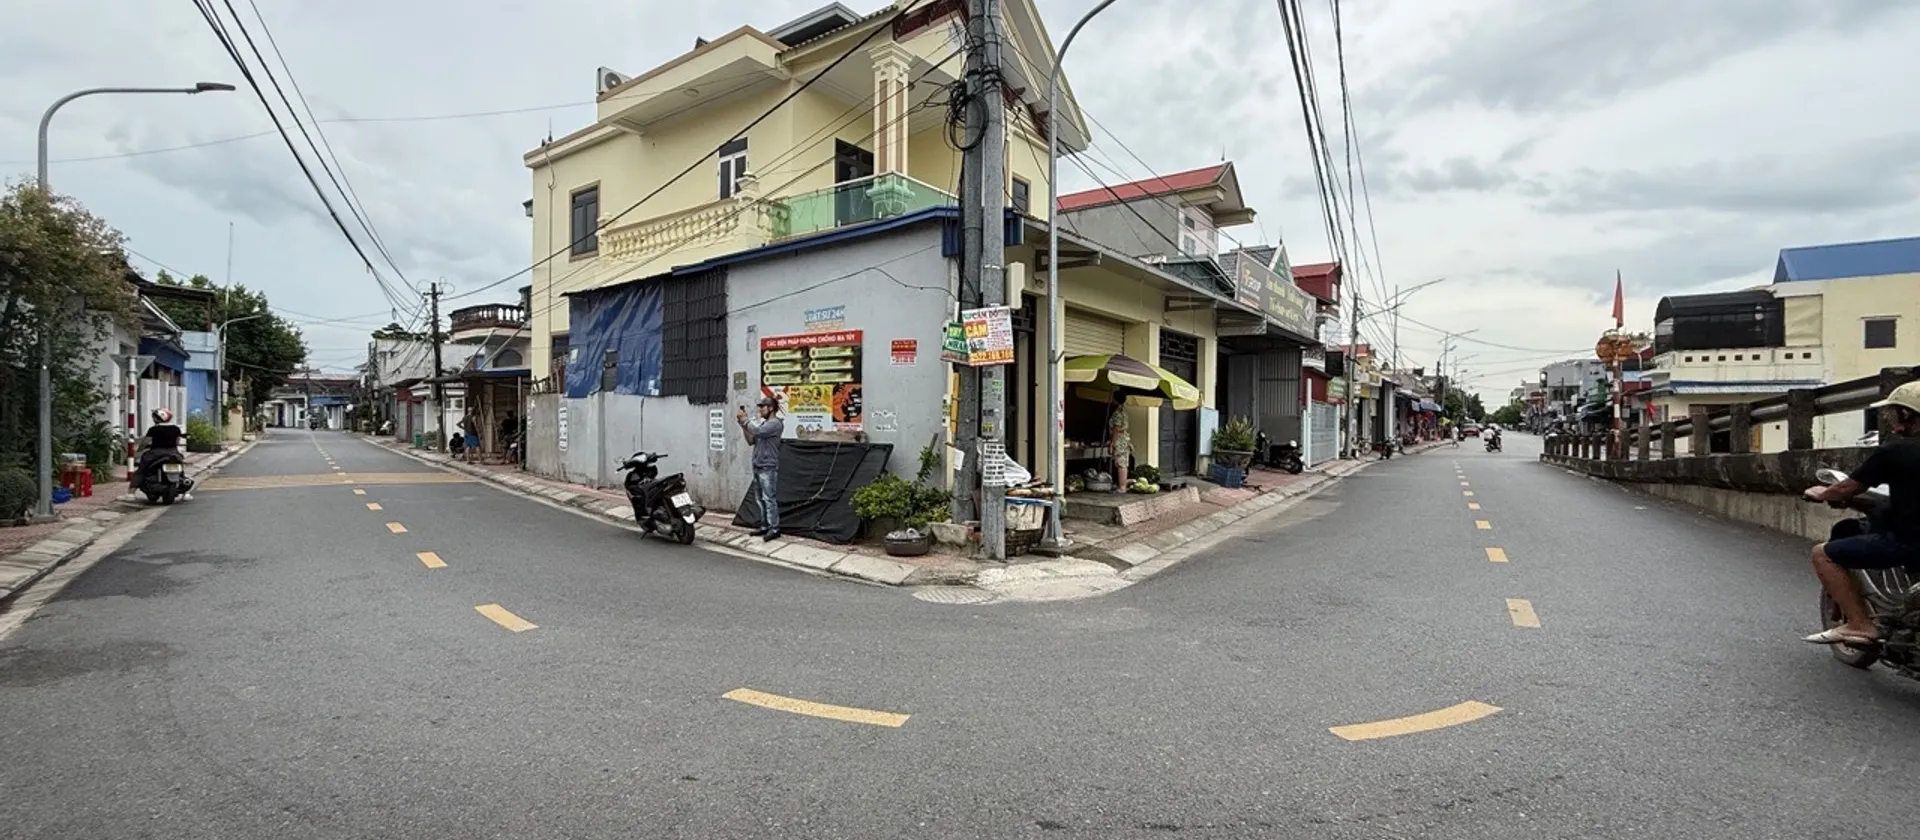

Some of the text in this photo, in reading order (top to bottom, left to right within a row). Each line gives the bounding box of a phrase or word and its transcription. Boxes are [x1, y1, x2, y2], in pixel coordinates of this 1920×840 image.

[766, 339, 776, 347] CÁC
[788, 337, 799, 345] PHÁP
[800, 336, 817, 345] PHÒNG
[818, 334, 836, 343] CHỐNG
[837, 334, 845, 342] MA
[845, 332, 855, 341] TÚY
